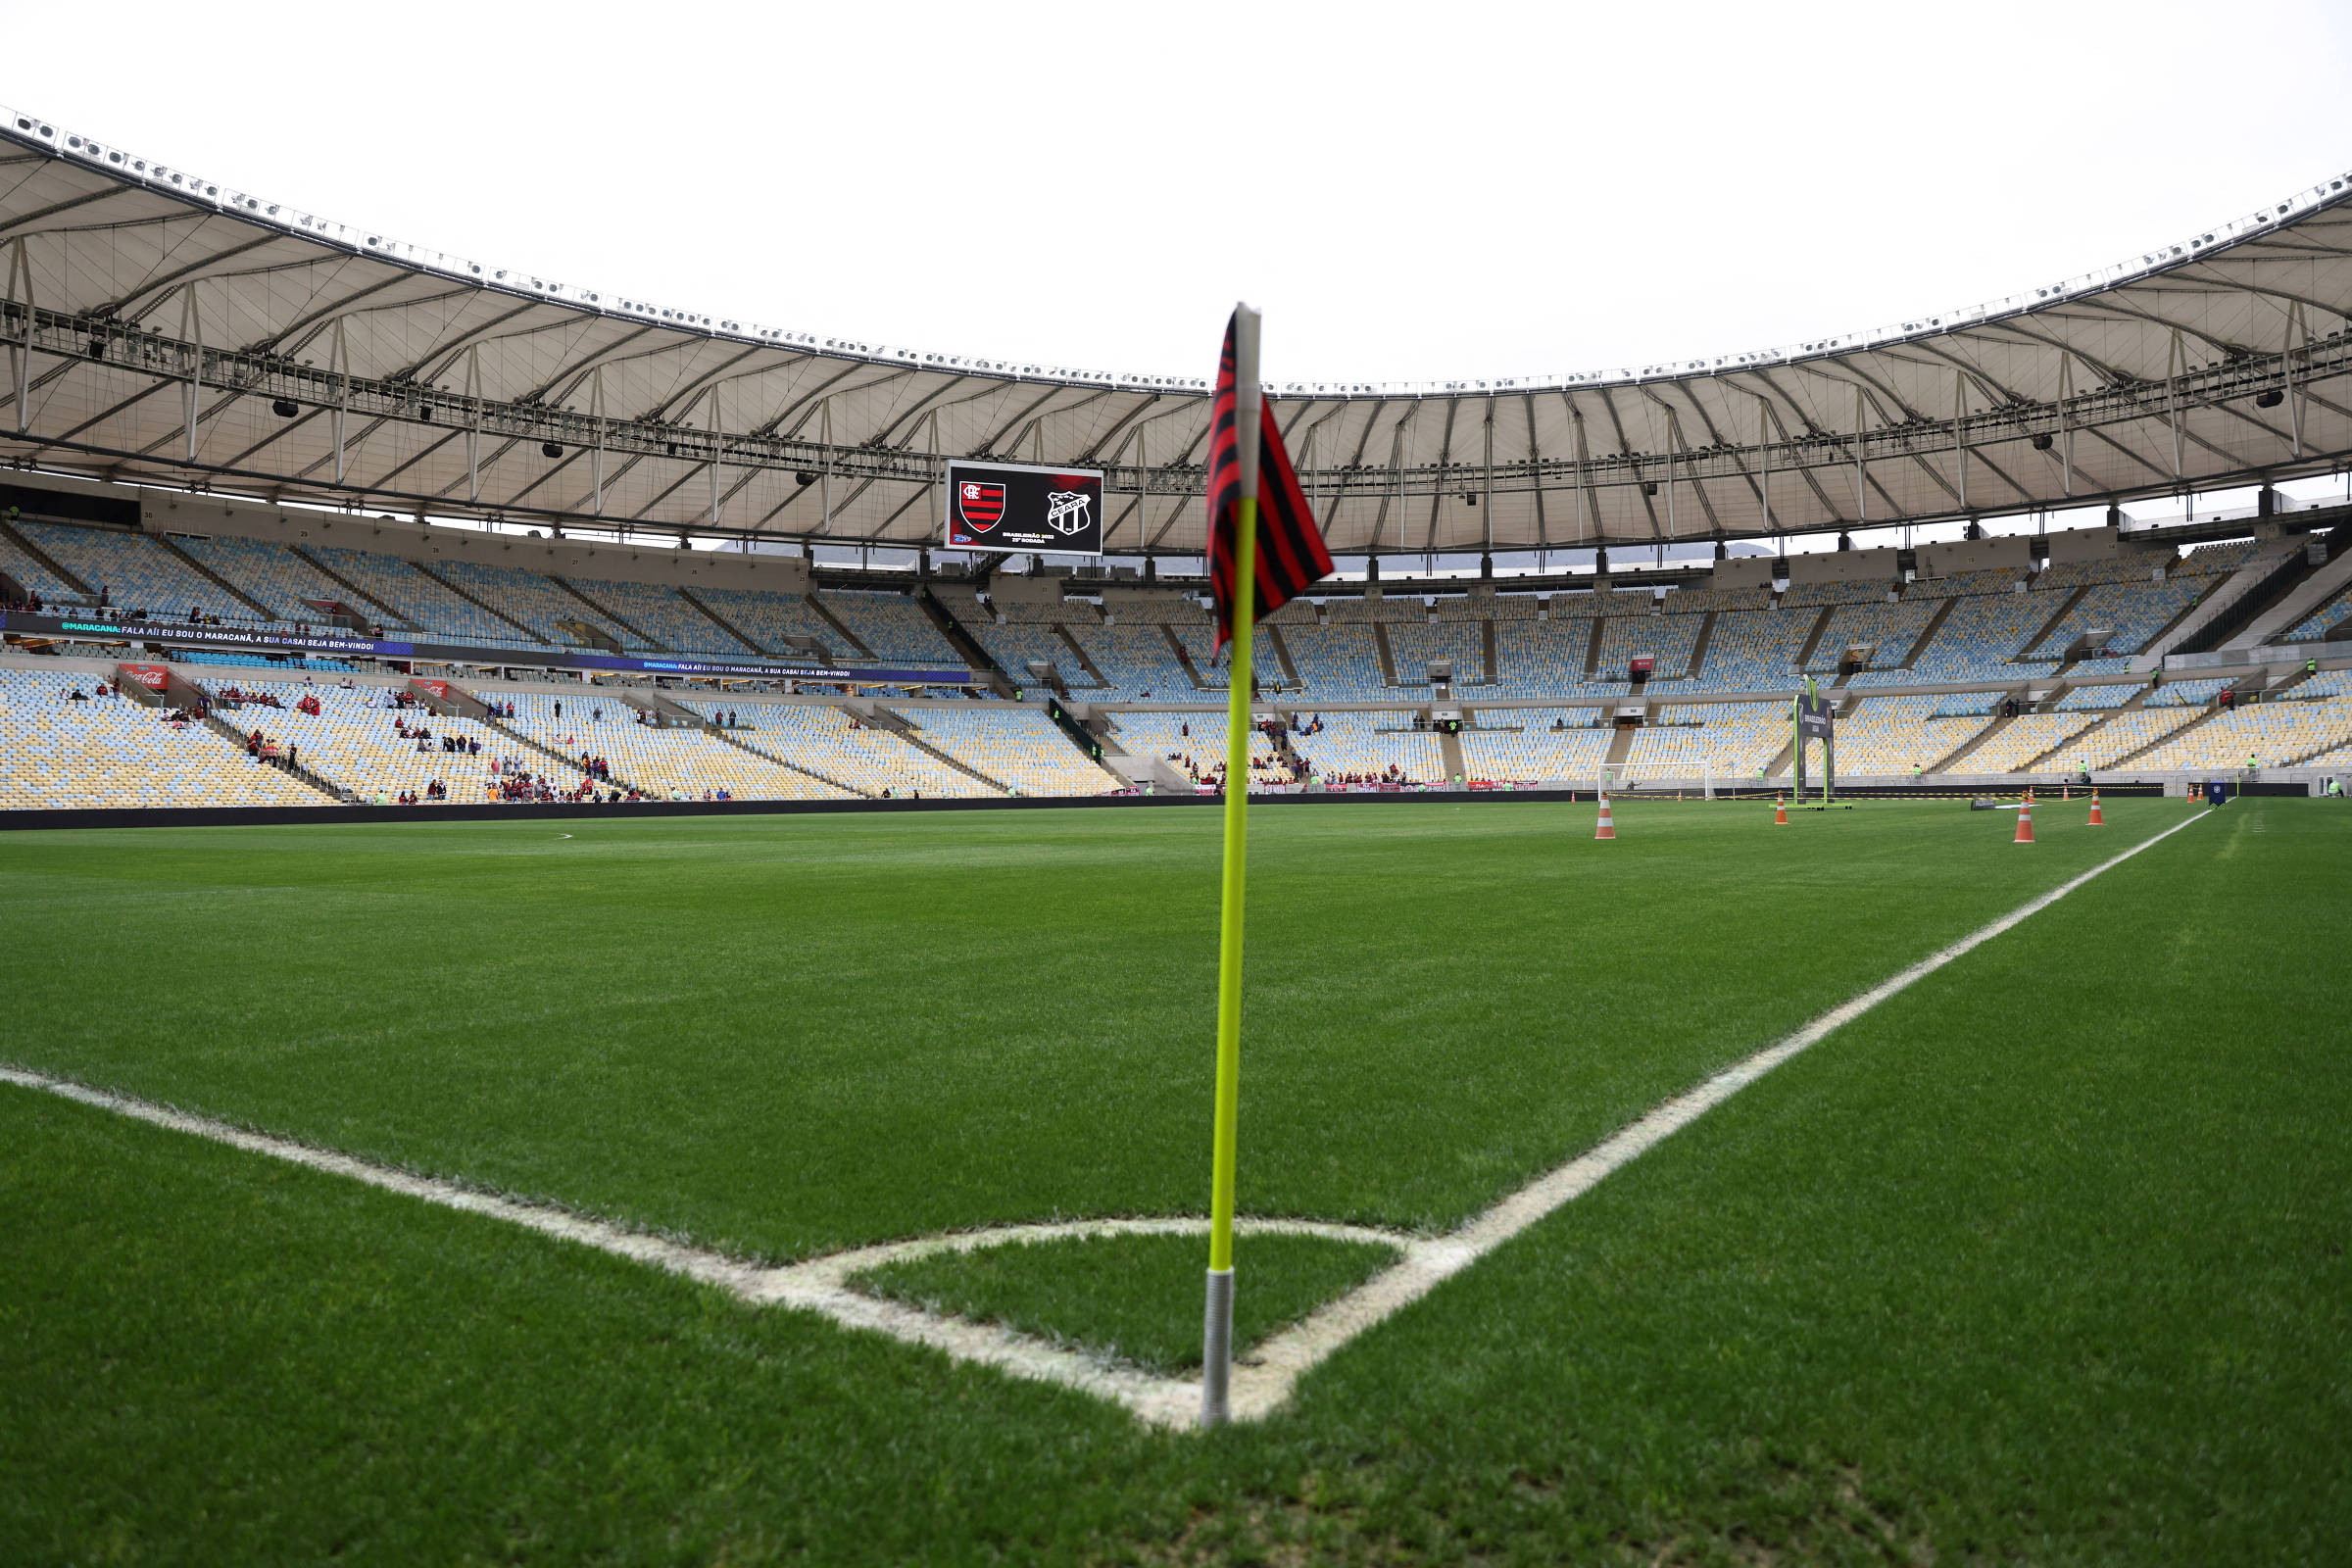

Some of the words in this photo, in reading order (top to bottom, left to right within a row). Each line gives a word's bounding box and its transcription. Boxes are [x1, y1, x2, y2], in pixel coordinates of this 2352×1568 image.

[122, 626, 145, 635] FALA
[205, 632, 254, 644] MARACANÃ,
[329, 641, 374, 651] BEM-VINDO!
